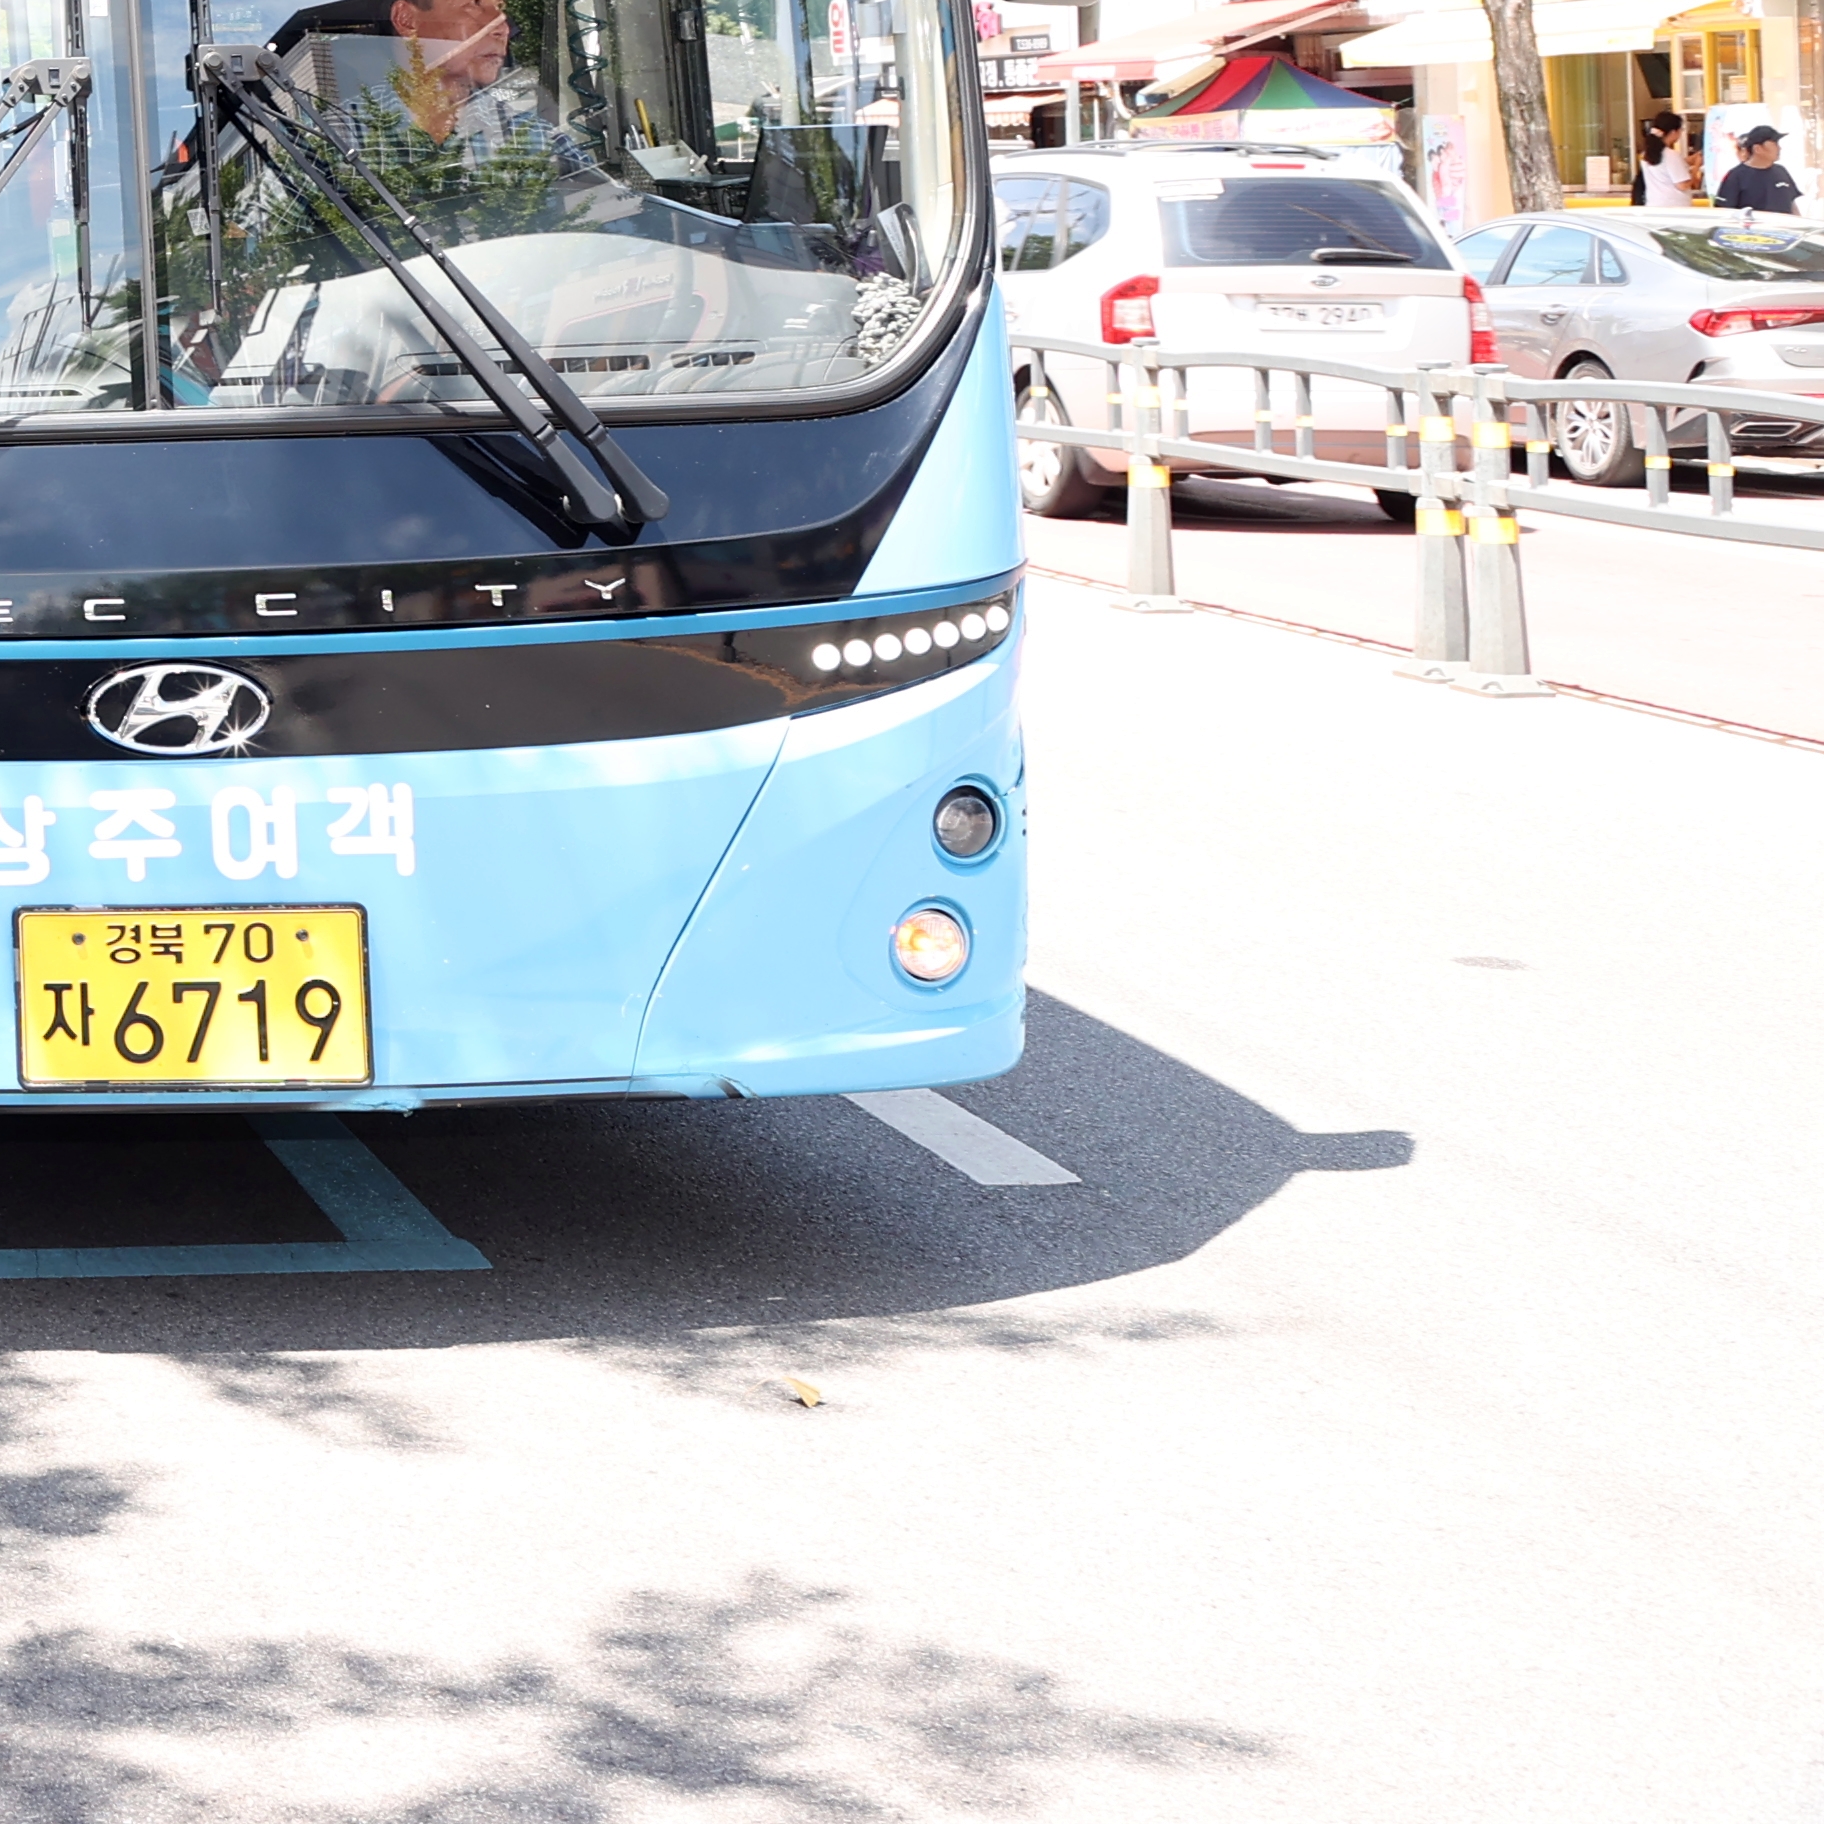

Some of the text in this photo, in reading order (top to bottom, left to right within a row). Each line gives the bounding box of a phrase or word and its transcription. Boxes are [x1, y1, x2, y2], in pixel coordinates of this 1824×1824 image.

[255, 577, 626, 616] CITY
[106, 922, 273, 967] 경북 70
